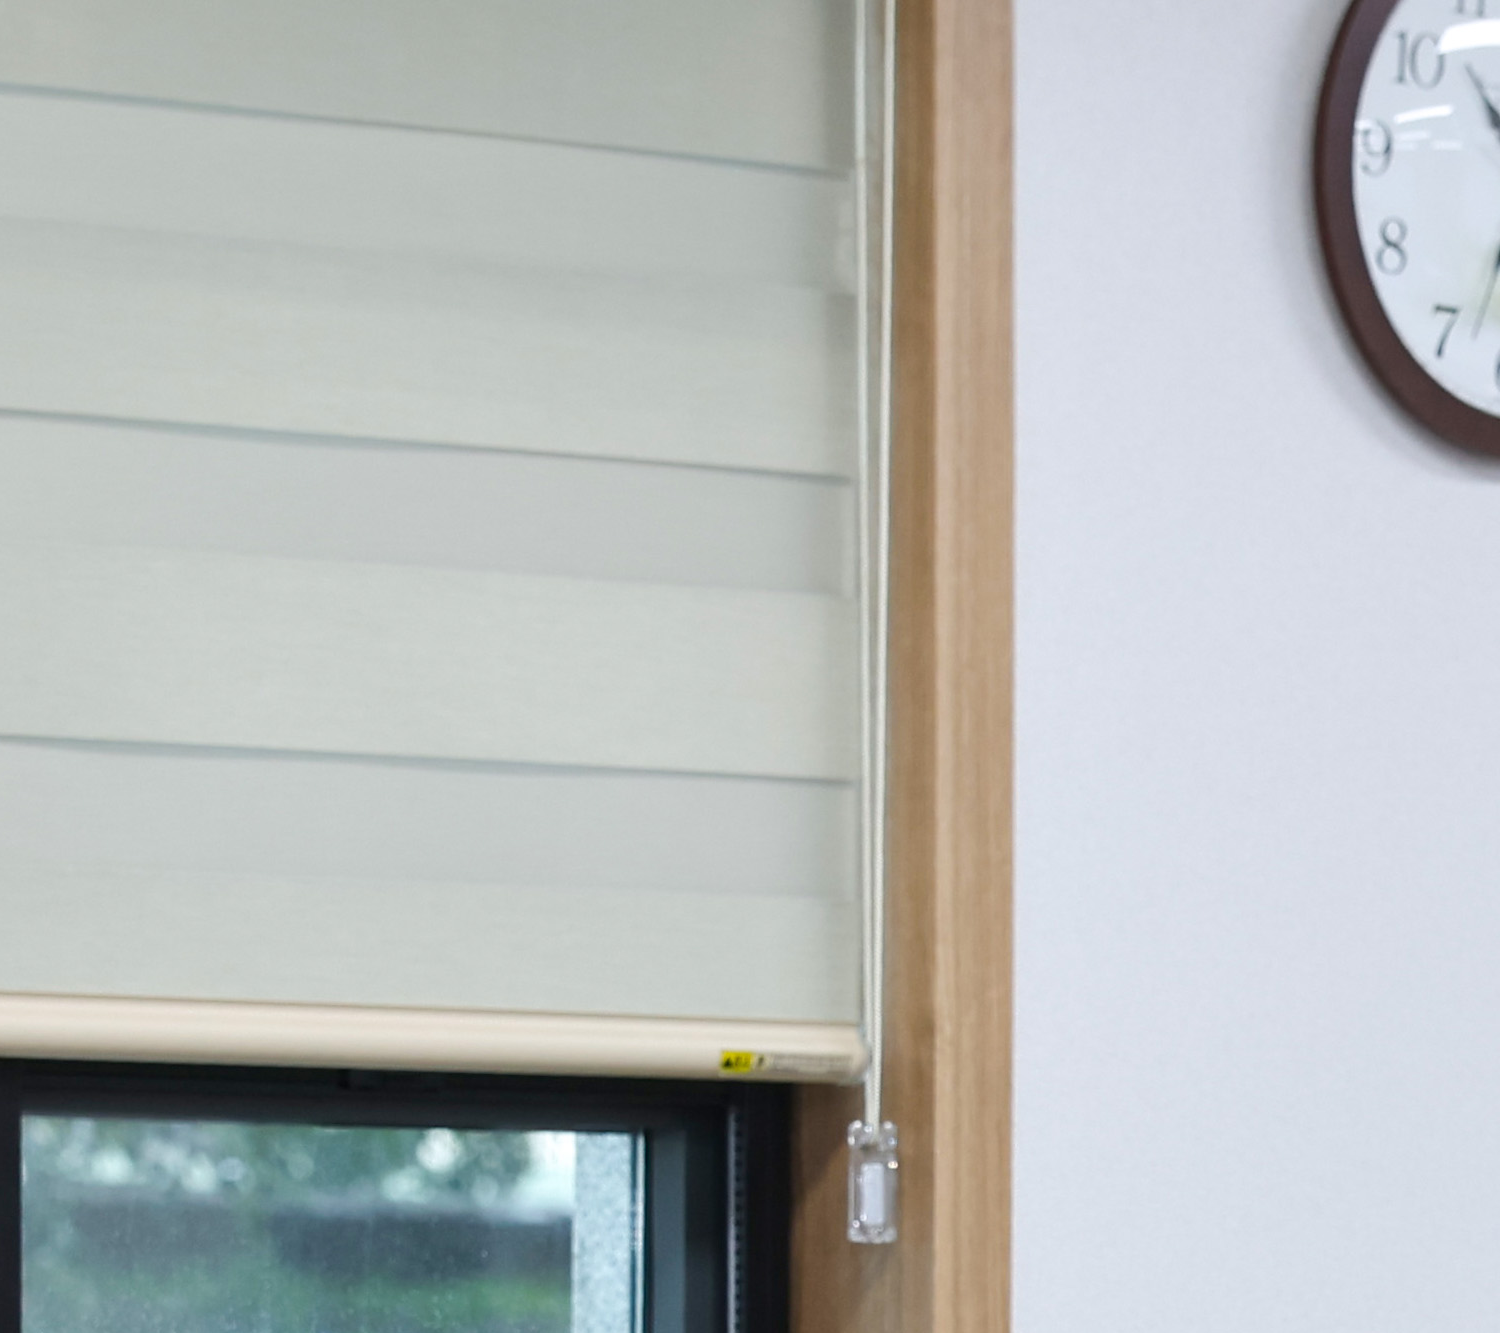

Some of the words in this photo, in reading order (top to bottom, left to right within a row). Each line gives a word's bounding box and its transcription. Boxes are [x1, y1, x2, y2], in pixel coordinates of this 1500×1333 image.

[1395, 30, 1445, 90] 10
[1358, 118, 1393, 176] 9
[1375, 217, 1408, 275] 8
[1431, 303, 1462, 358] 7
